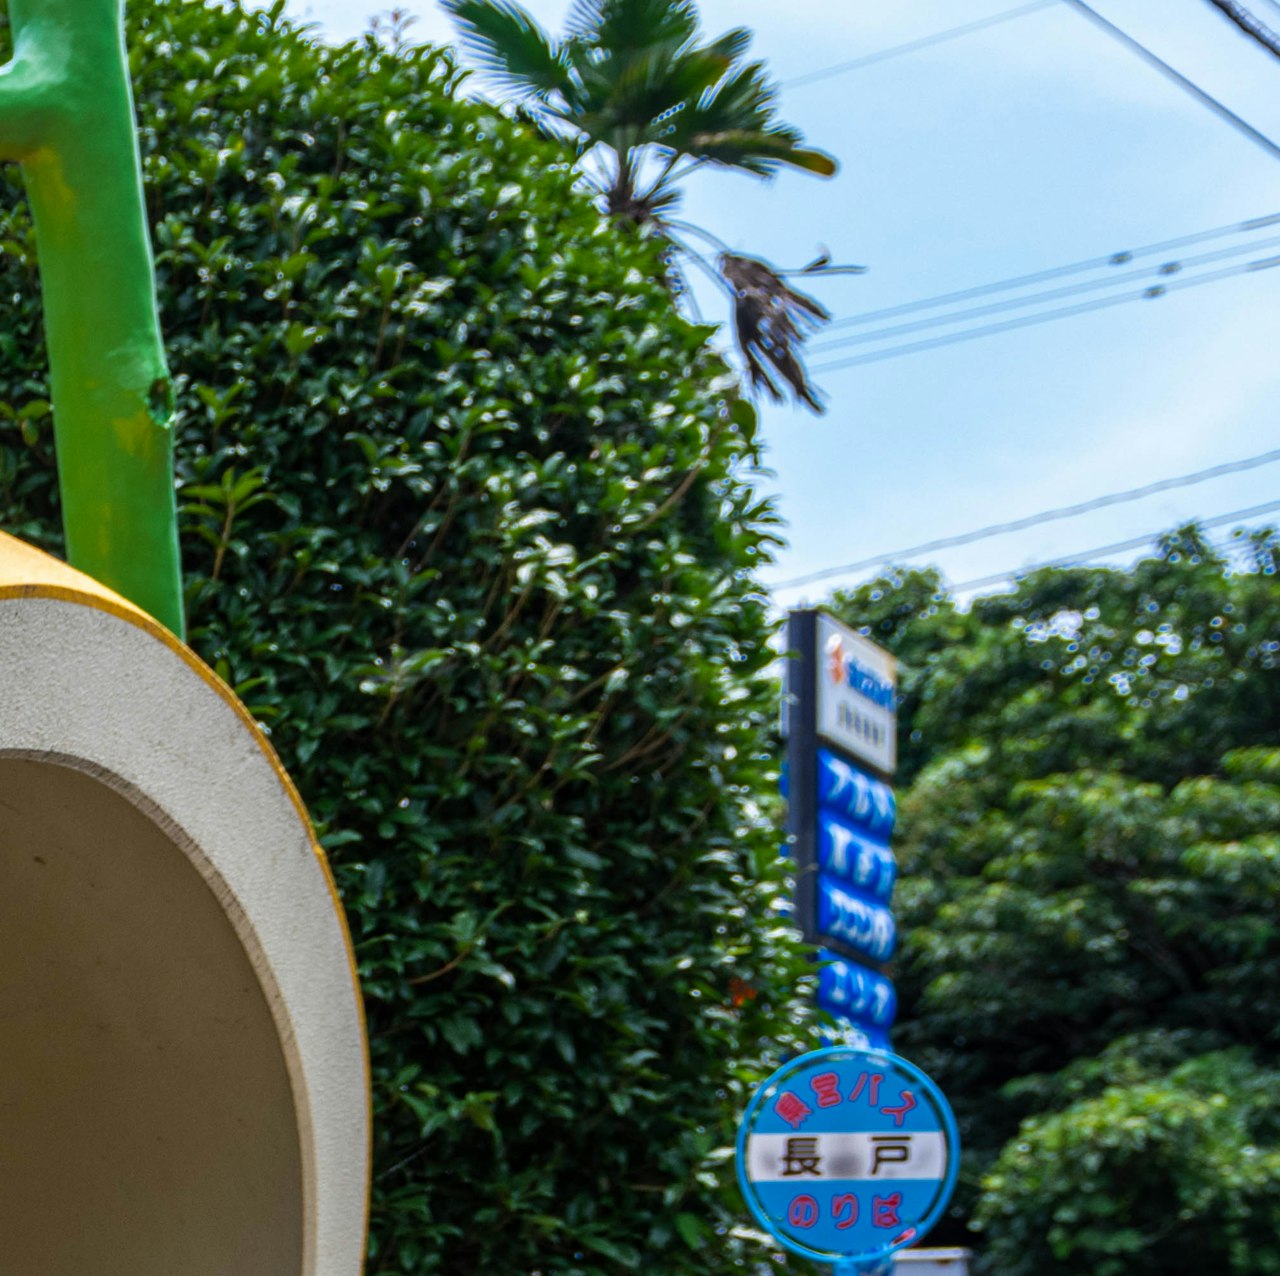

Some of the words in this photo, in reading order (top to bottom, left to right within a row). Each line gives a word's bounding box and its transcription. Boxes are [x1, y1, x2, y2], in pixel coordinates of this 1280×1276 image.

[781, 1136, 913, 1176] 長戸
[787, 1192, 903, 1229] のりば
